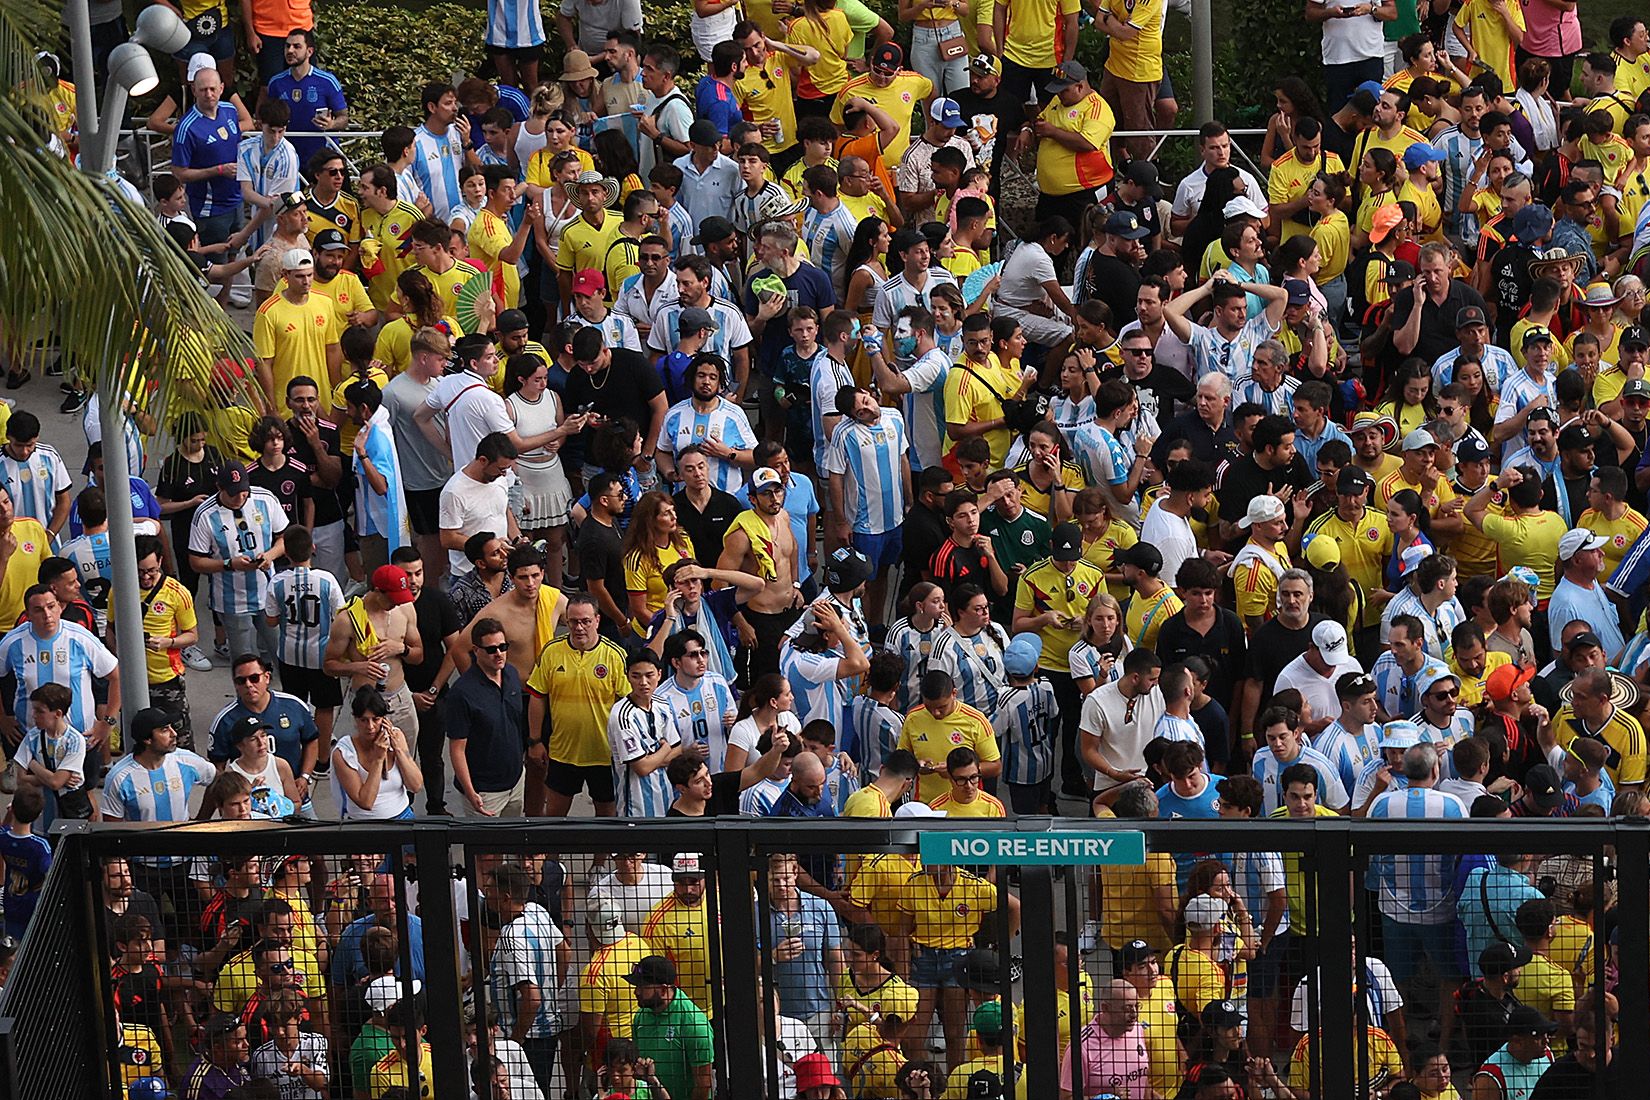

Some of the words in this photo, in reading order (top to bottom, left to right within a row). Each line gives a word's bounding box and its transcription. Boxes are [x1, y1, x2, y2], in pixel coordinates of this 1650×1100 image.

[231, 470, 241, 483] B
[235, 532, 257, 552] 10
[290, 583, 314, 593] MESSI
[284, 594, 321, 628] 10
[692, 718, 708, 740] 10
[951, 839, 989, 857] NO
[997, 839, 1115, 857] RE-ENTRY
